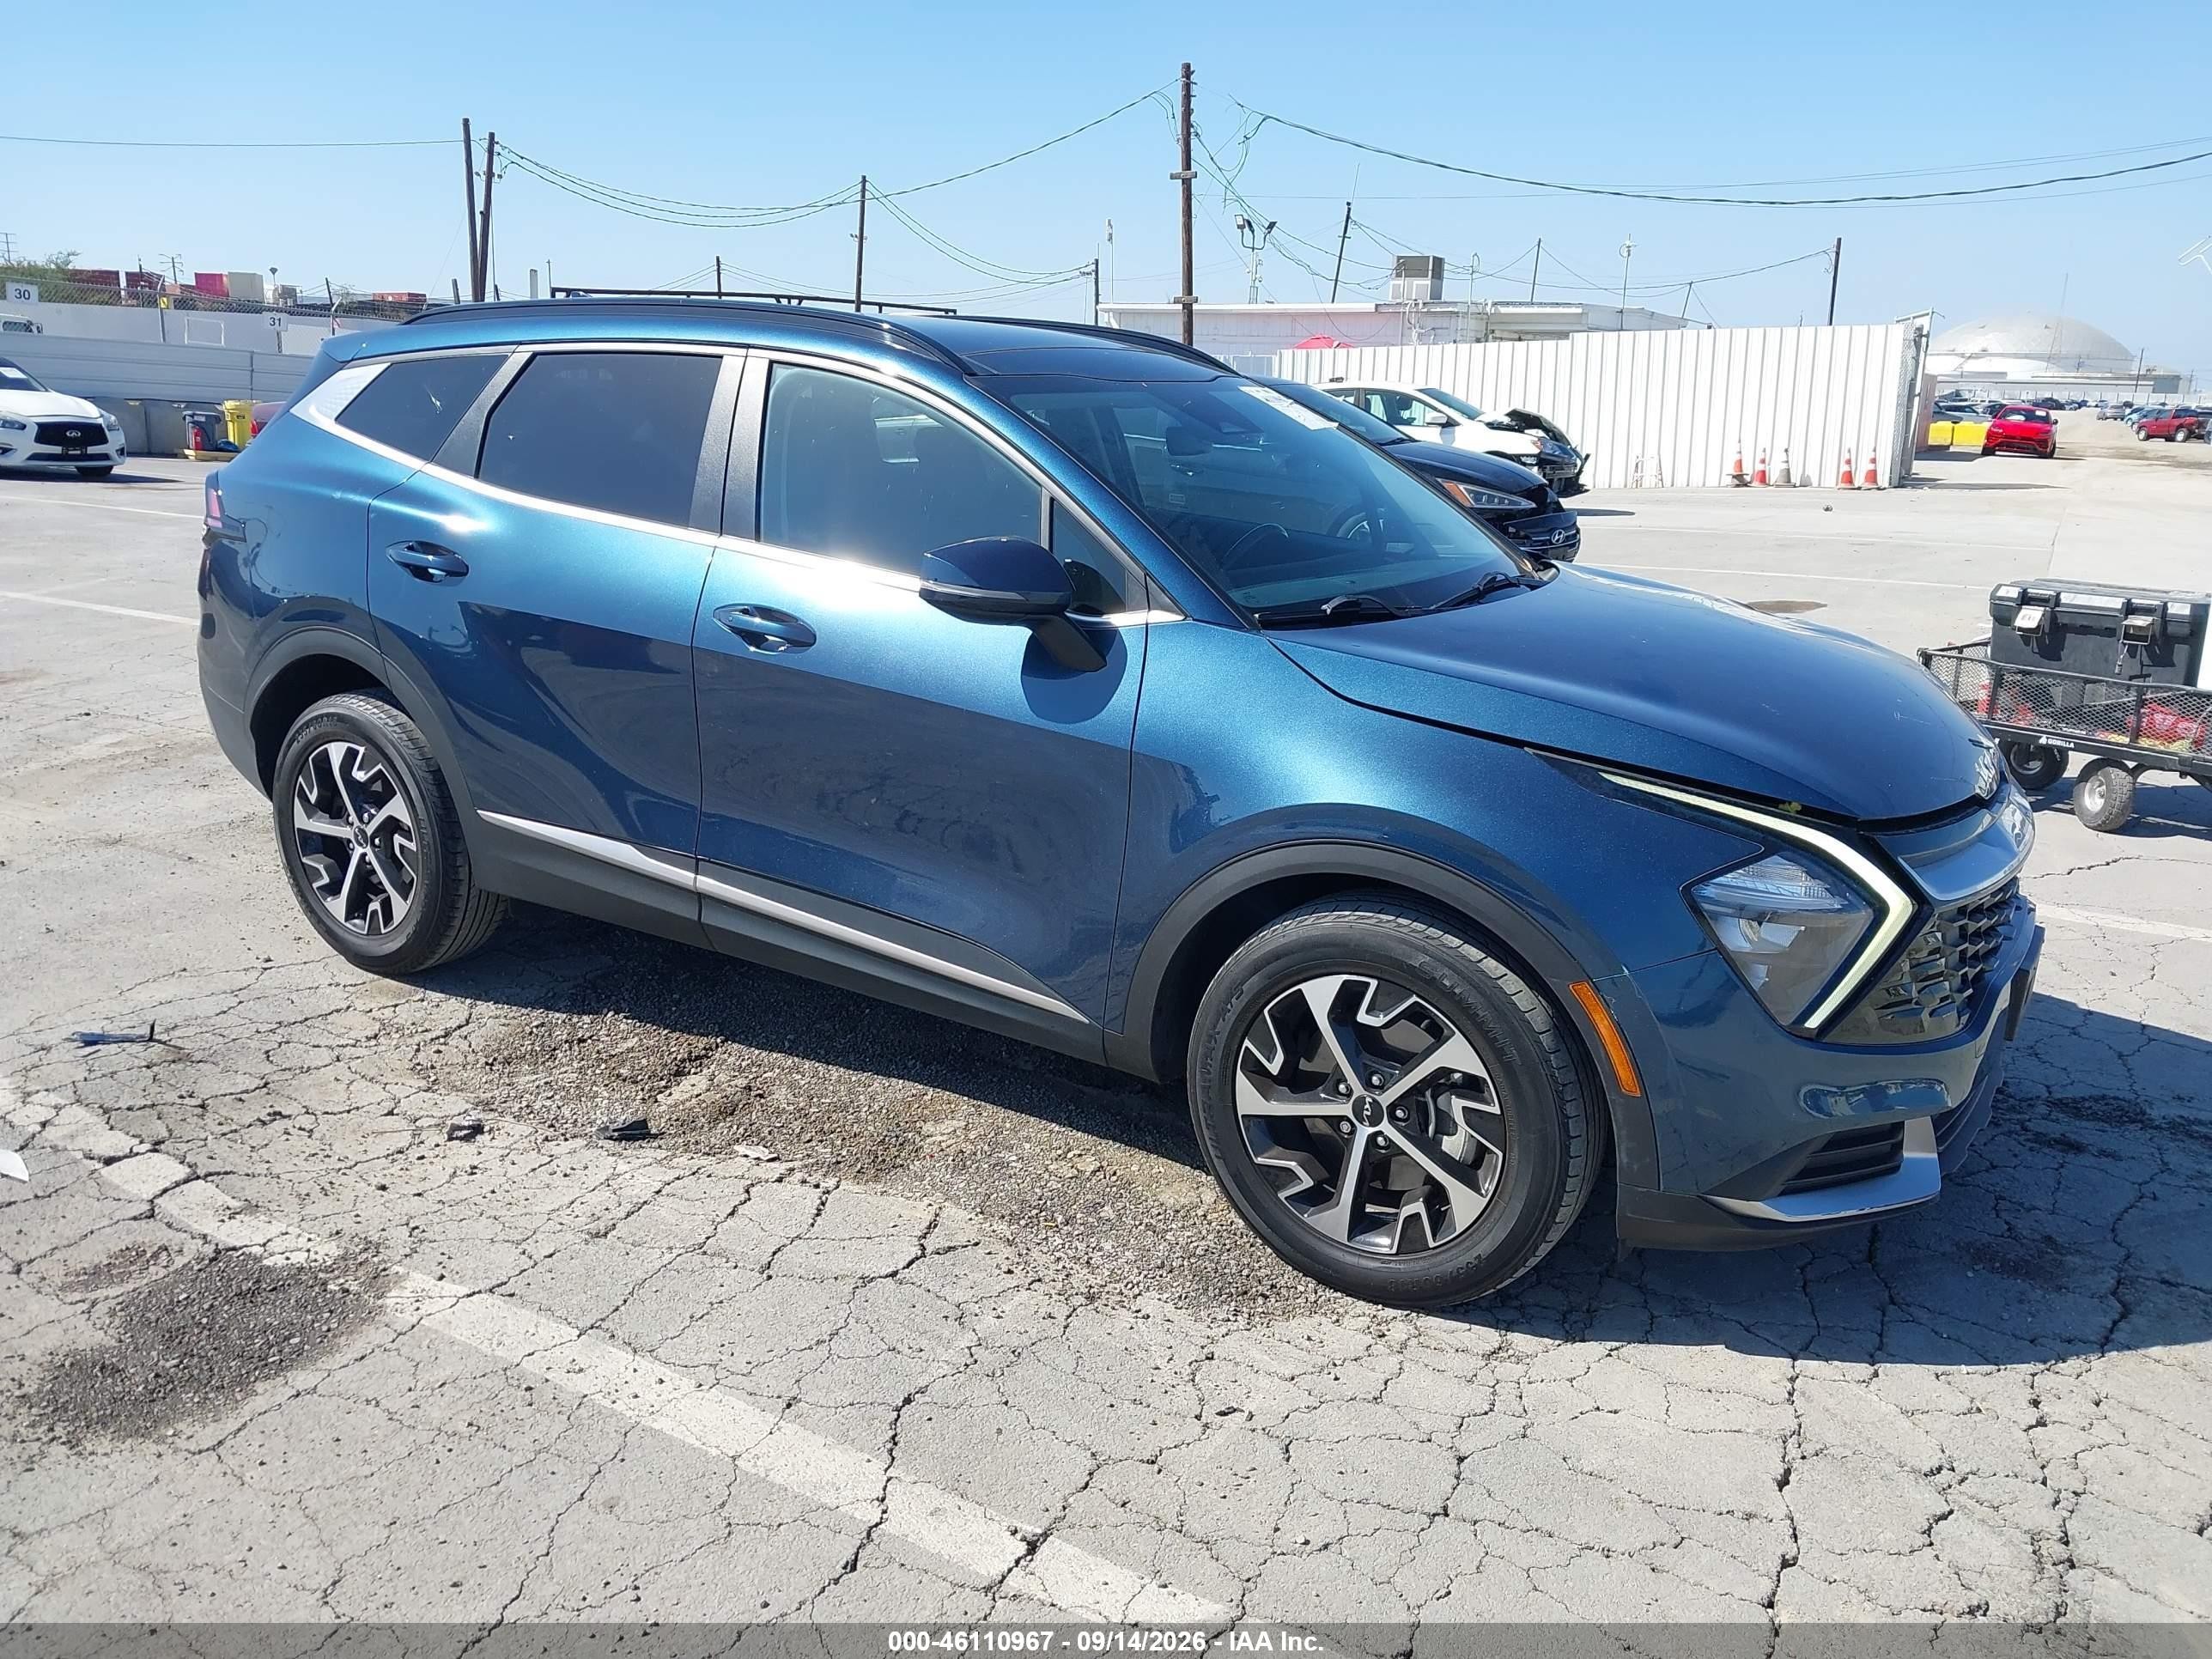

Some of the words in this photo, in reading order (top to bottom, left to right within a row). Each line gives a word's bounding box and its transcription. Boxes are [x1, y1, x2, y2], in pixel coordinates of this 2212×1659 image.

[14, 288, 31, 301] 30
[270, 316, 282, 327] 31
[2047, 738, 2075, 749] GORILLA
